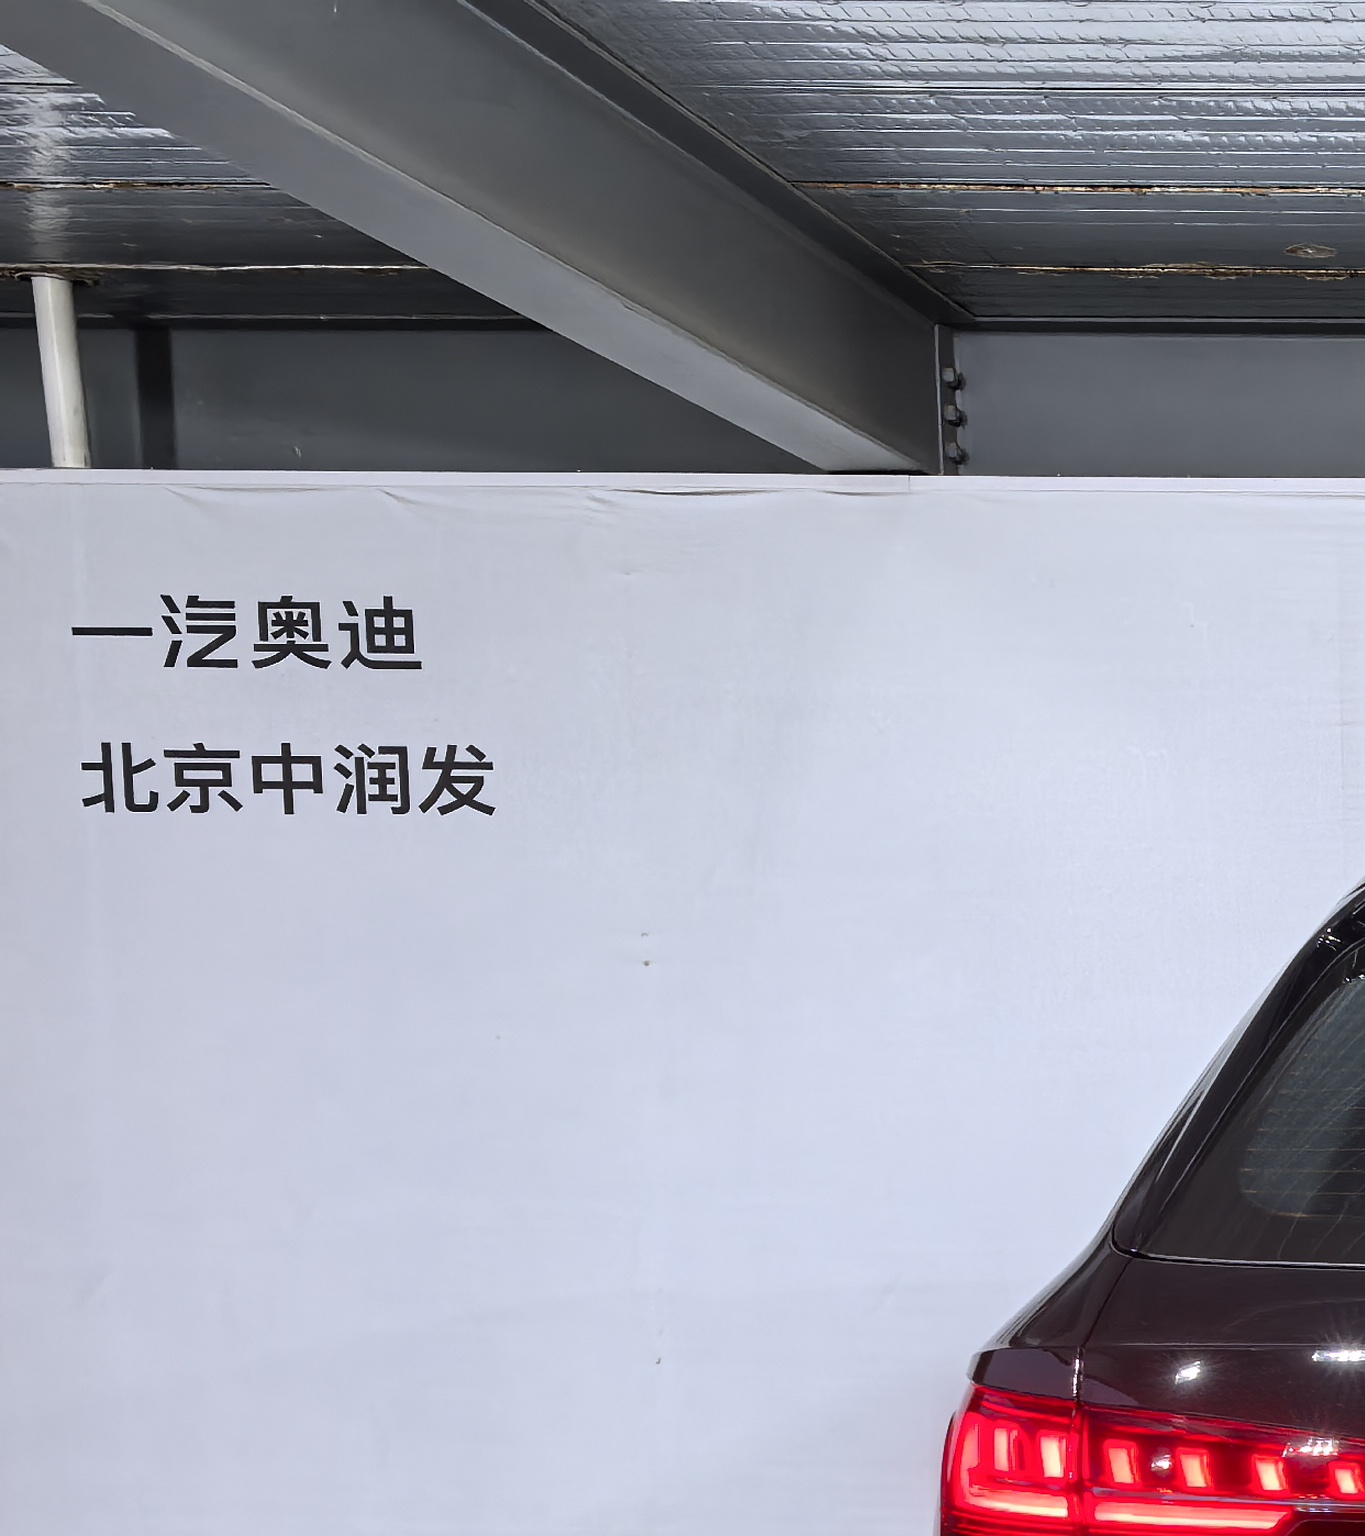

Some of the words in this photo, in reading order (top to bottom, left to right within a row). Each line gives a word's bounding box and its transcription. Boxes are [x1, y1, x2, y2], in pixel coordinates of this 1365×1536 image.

[71, 594, 422, 670] 一汽奥迪
[80, 741, 496, 816] 北京中润发
